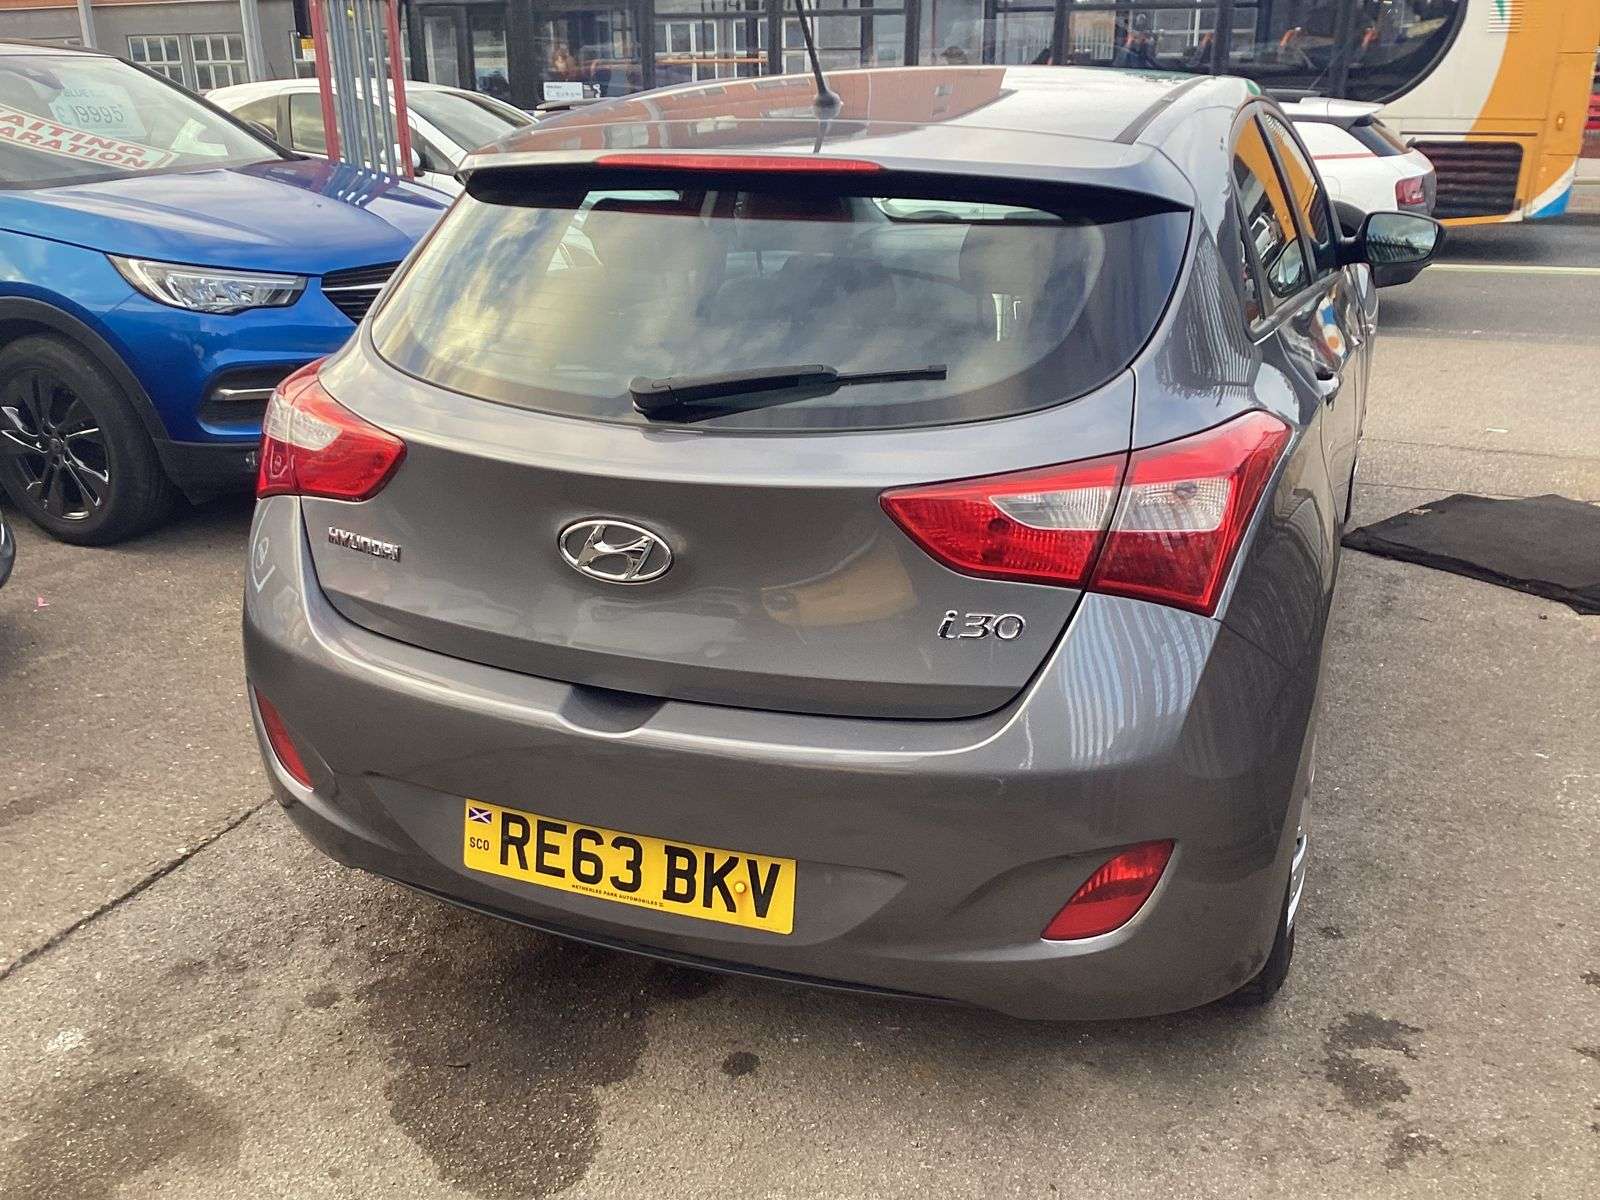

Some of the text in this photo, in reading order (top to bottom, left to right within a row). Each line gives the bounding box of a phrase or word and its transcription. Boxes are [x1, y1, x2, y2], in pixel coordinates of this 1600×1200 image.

[328, 525, 401, 562] HYUNDAI
[937, 609, 1026, 640] i30
[469, 836, 490, 852] SCO
[500, 811, 781, 919] RE63 BKV
